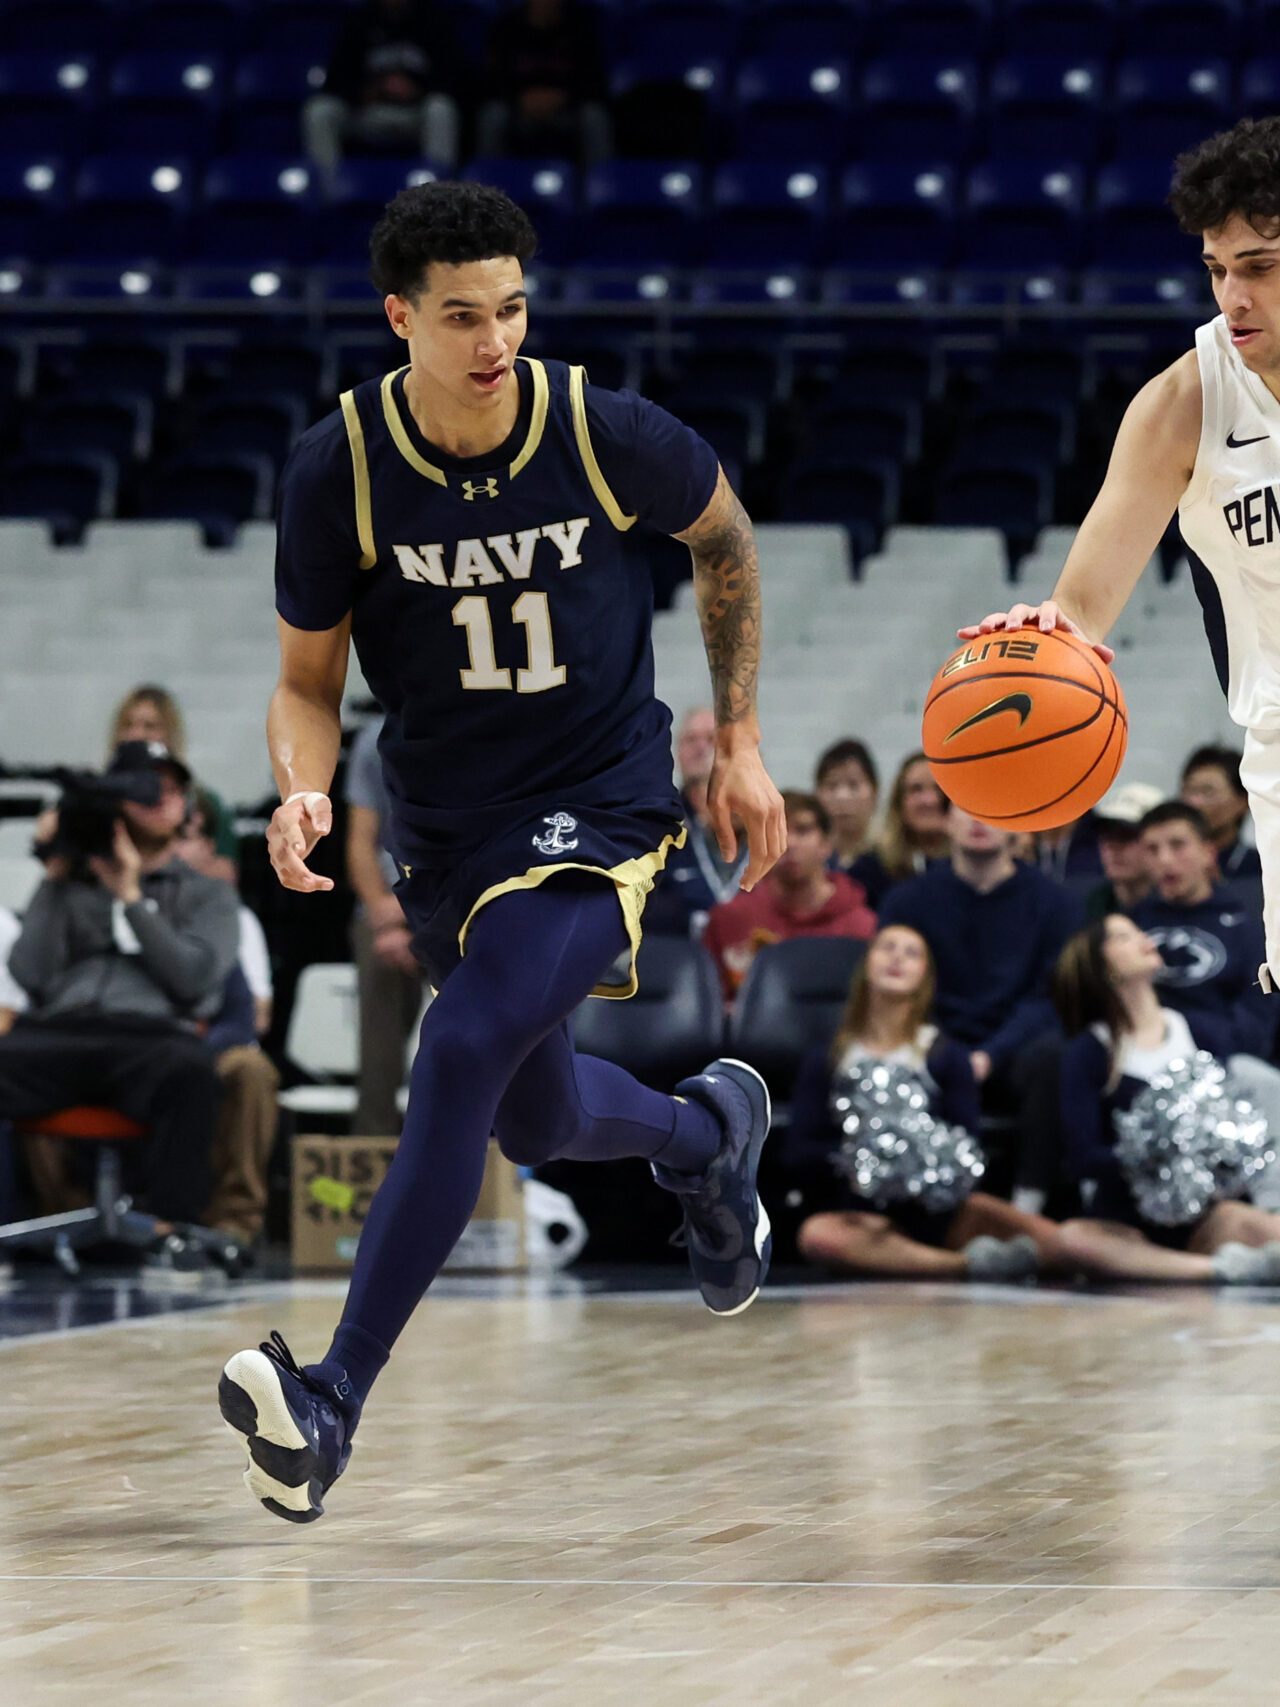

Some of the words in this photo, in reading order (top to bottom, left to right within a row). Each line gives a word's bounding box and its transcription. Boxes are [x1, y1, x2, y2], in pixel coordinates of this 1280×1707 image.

[393, 517, 590, 588] NAVY
[451, 591, 567, 694] 11
[942, 640, 1040, 678] ELITE
